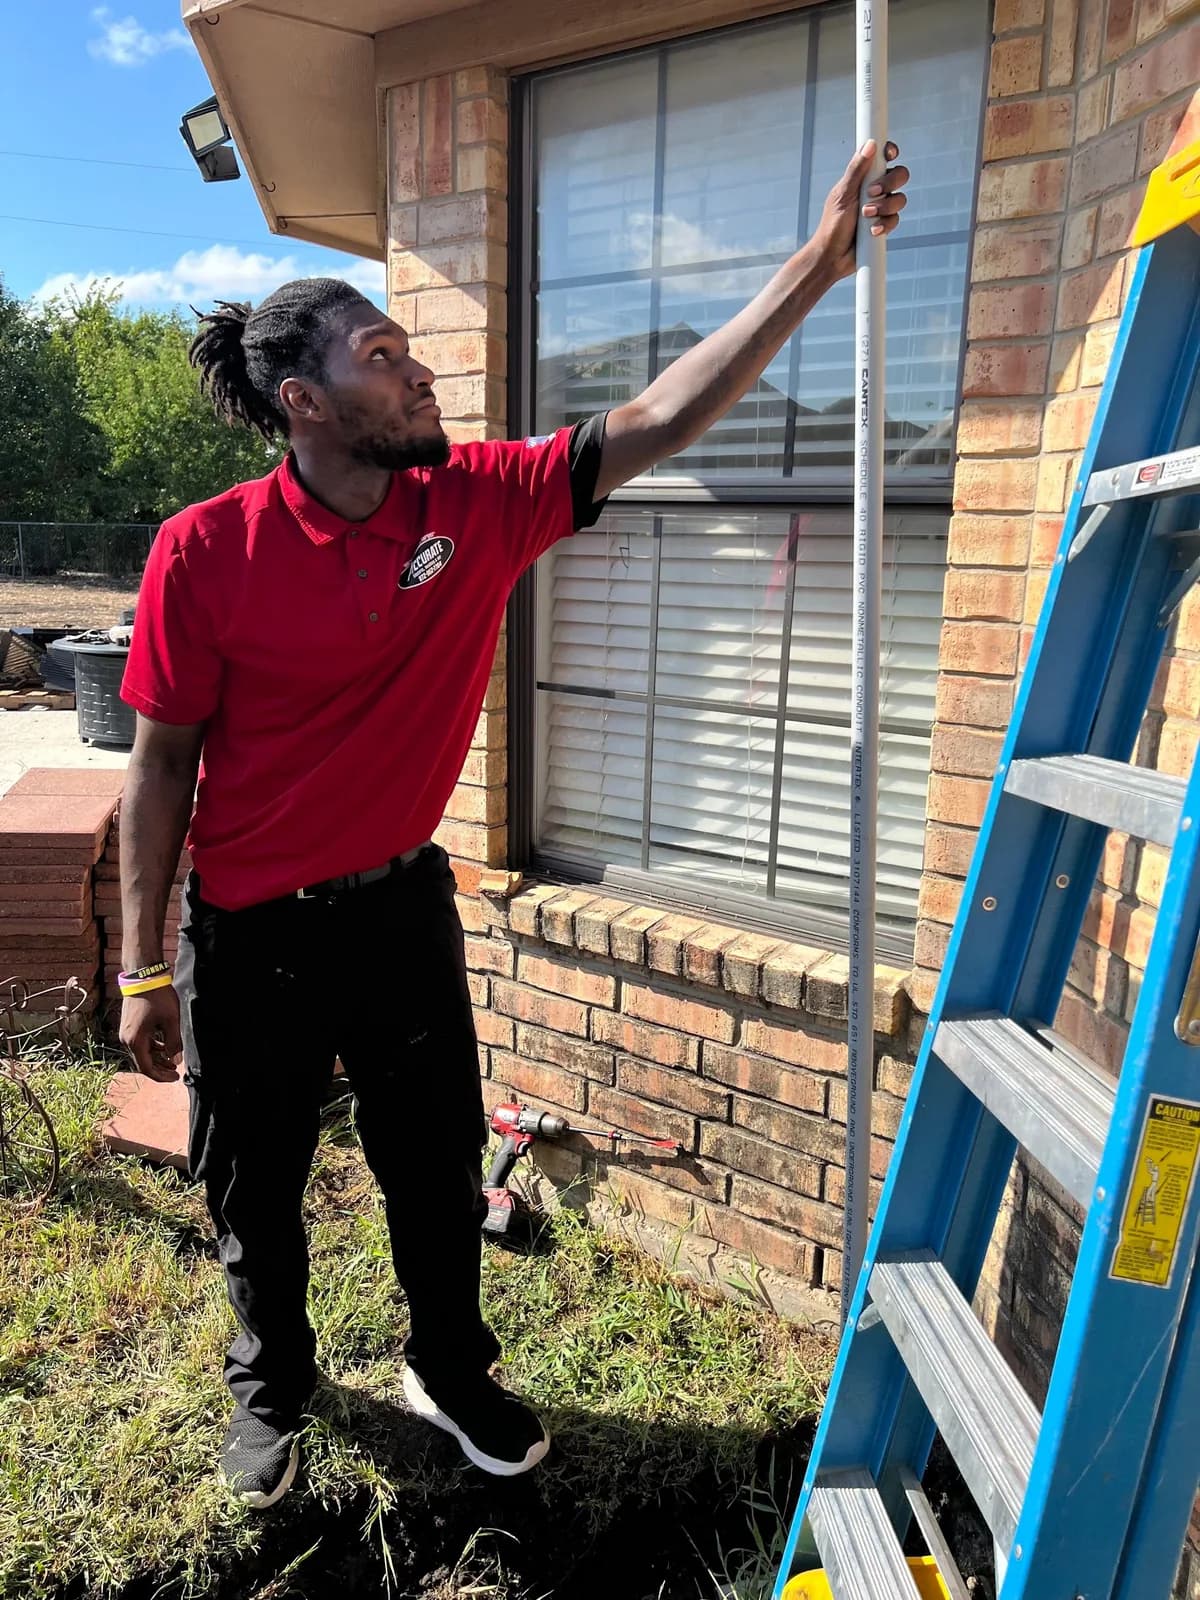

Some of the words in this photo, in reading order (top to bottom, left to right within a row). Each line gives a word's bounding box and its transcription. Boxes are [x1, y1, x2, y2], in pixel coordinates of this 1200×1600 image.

[861, 368, 869, 429] CANTEX
[859, 440, 868, 499] SCHEDULE
[859, 507, 867, 522] 40
[858, 529, 866, 566] RIGID
[856, 601, 865, 679] NONMETALLIC
[855, 685, 864, 733] CONDUIT
[852, 909, 860, 959] CONFORMS
[852, 966, 859, 978] TO
[852, 982, 859, 994] UL
[1155, 1103, 1200, 1121] CAUTION
[847, 1141, 856, 1202] UNDERGROUND
